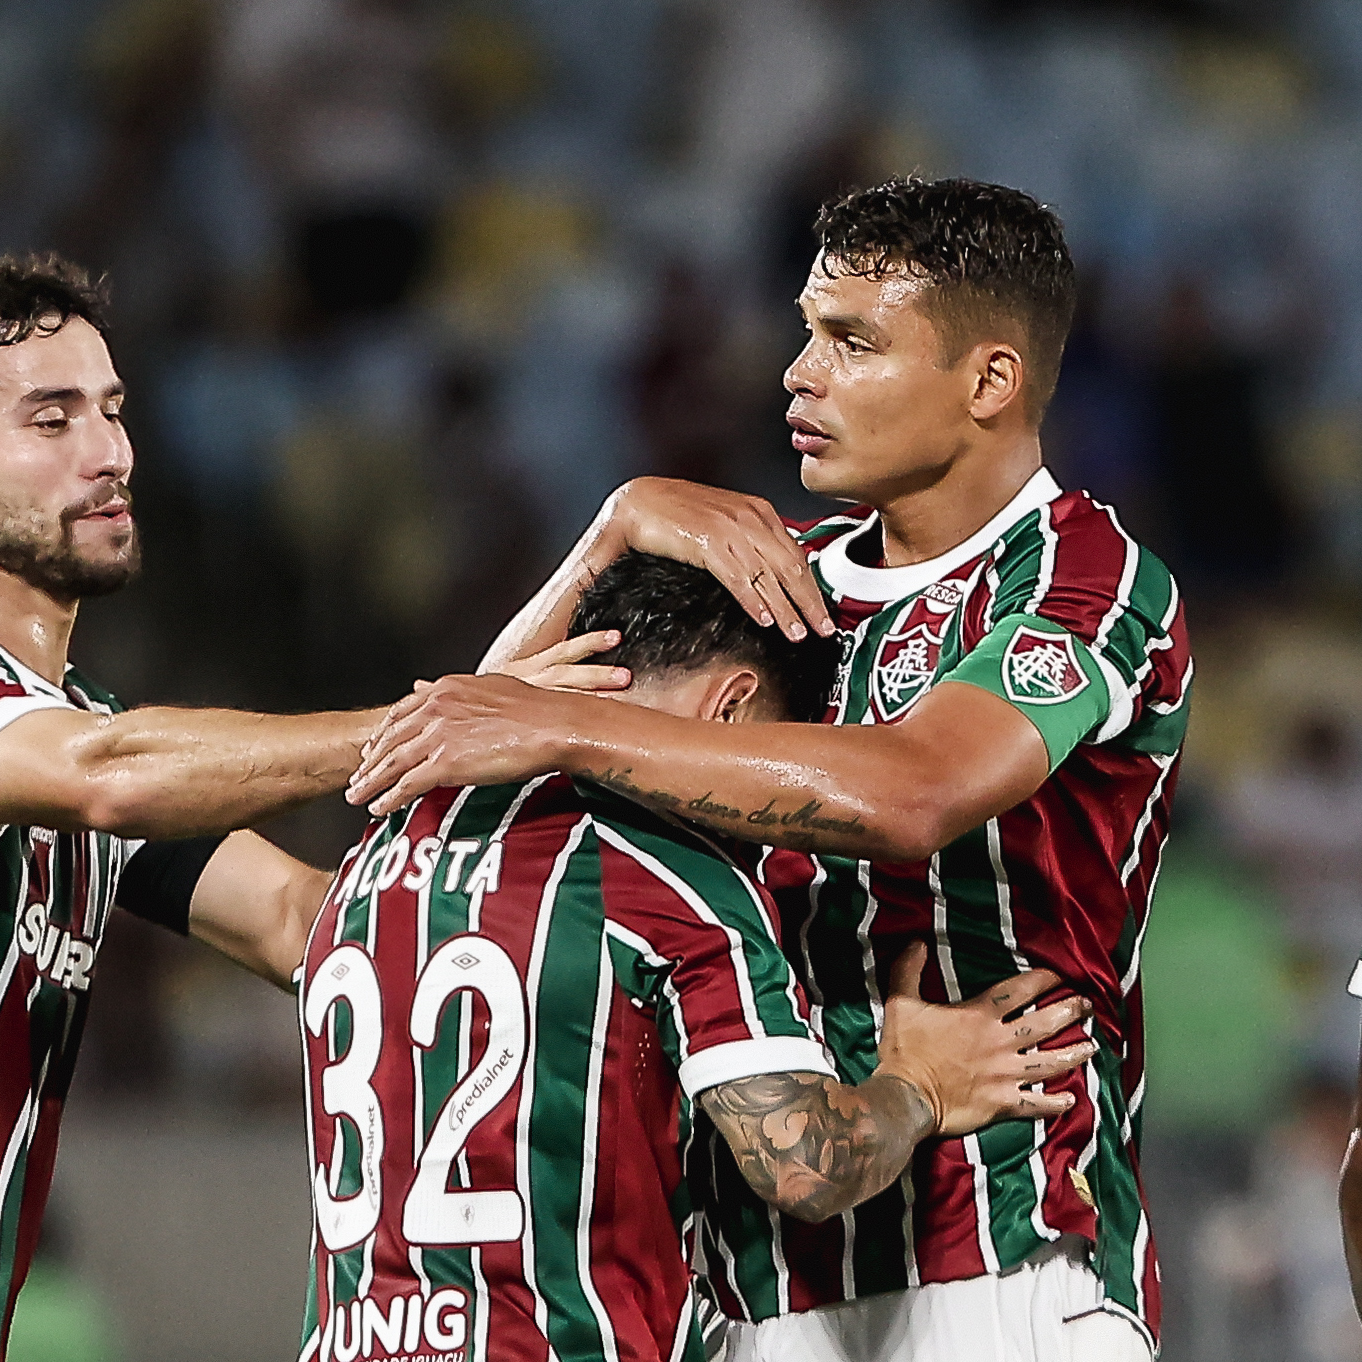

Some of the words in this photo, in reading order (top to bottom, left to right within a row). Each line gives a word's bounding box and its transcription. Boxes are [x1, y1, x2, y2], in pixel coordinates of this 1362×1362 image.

[333, 834, 505, 907] ACOSTA
[305, 935, 527, 1252] 32
[456, 1047, 515, 1126] predialnet
